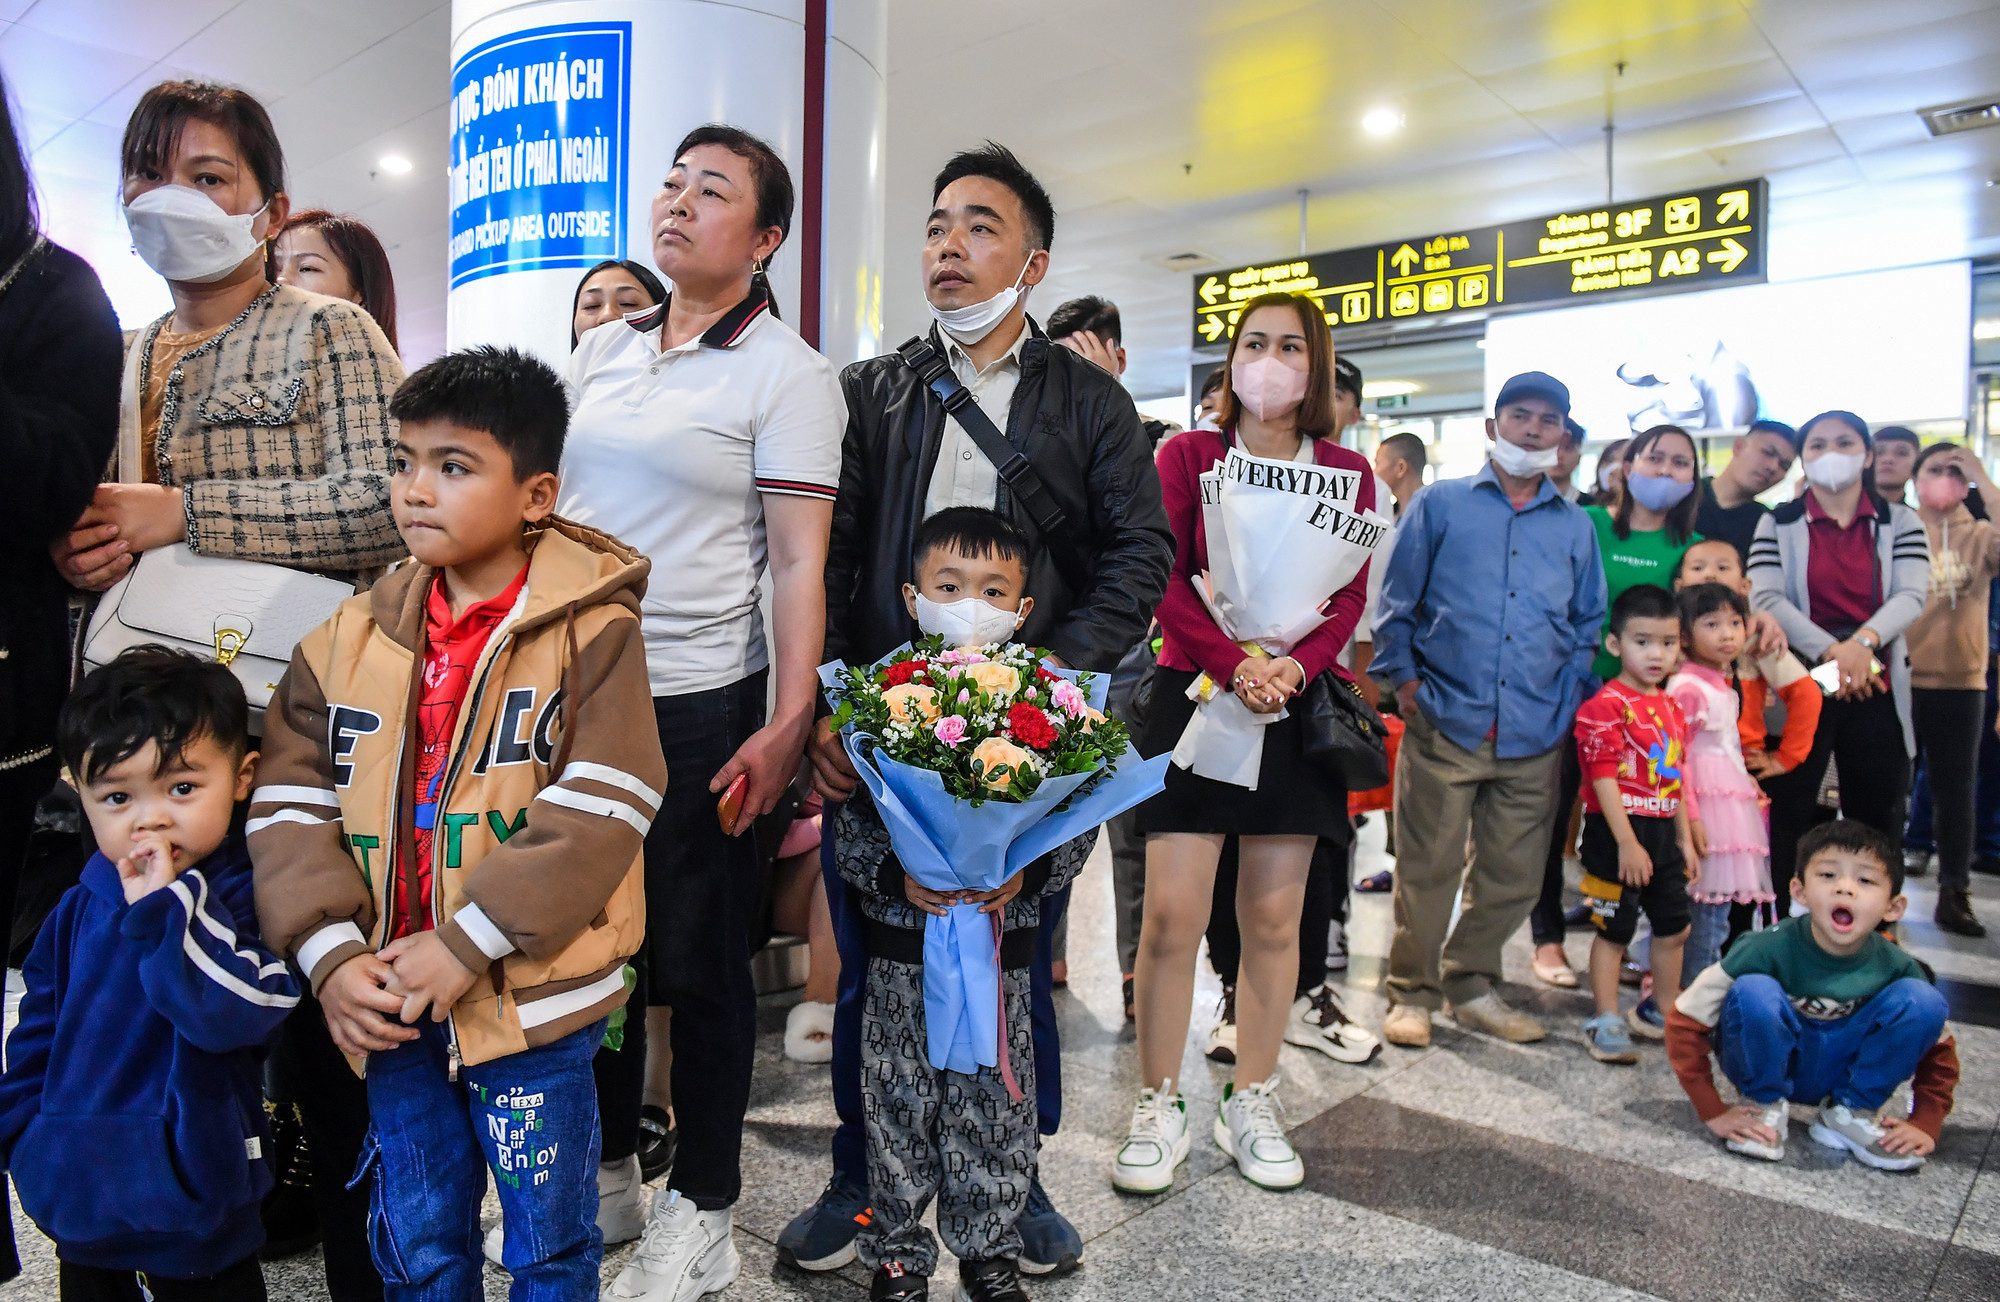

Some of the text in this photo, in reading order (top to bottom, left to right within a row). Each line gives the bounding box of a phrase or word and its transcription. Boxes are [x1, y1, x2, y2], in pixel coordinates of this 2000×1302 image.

[483, 63, 519, 115] ĐÓN
[524, 52, 604, 105] KHÁCH
[491, 138, 512, 193] TÊN
[514, 124, 524, 189] Ở
[525, 130, 557, 188] PHÍA
[560, 127, 609, 184] NGOÀI
[475, 218, 510, 250] PICKUP
[511, 213, 545, 243] AREA
[548, 210, 610, 239] OUTSIDE
[1614, 207, 1652, 238] 3F
[1658, 247, 1700, 278] A2
[1228, 454, 1356, 501] EVERYDAY
[512, 1096, 542, 1108] LEXA
[496, 1142, 559, 1178] Enjoy
